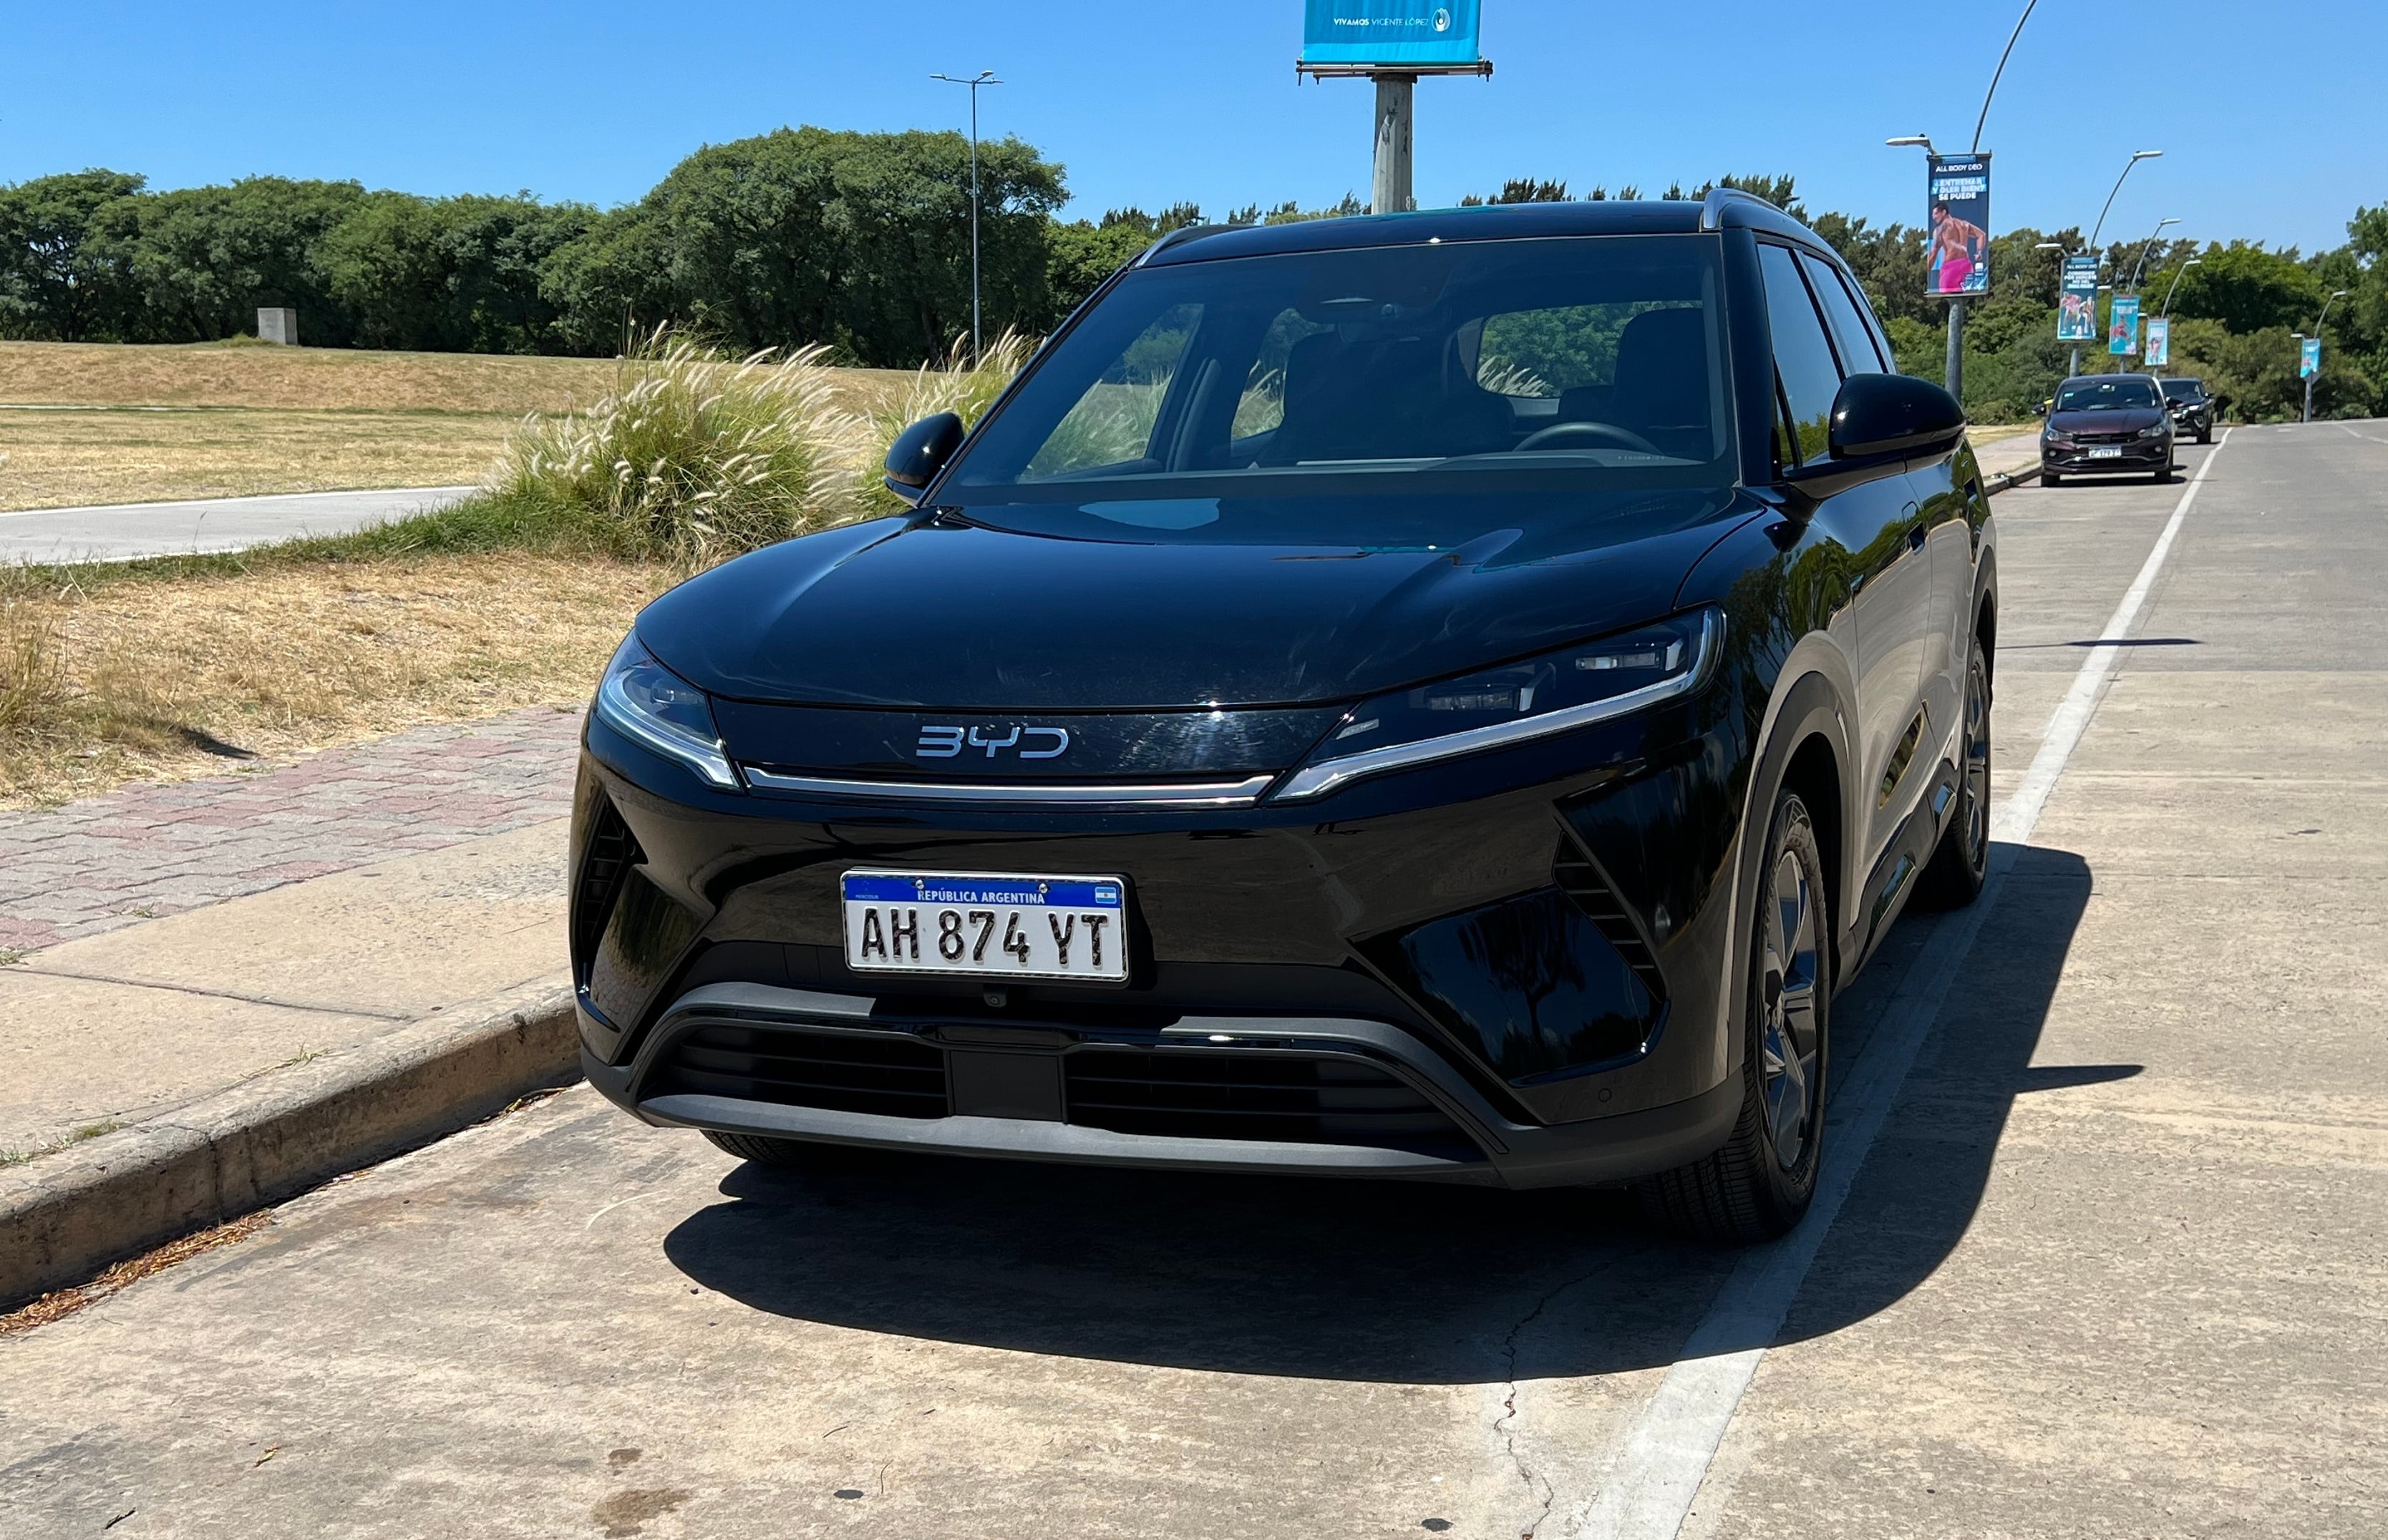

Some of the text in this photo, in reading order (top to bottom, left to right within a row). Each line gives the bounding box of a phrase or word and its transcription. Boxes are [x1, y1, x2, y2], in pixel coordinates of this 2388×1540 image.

[1372, 17, 1403, 26] VICENTE
[1404, 16, 1429, 26] LÓPEZ
[916, 726, 1069, 759] BYD
[917, 888, 1045, 905] REPÚBLICA ARGENTINA
[861, 907, 1109, 966] AH 874 YT
